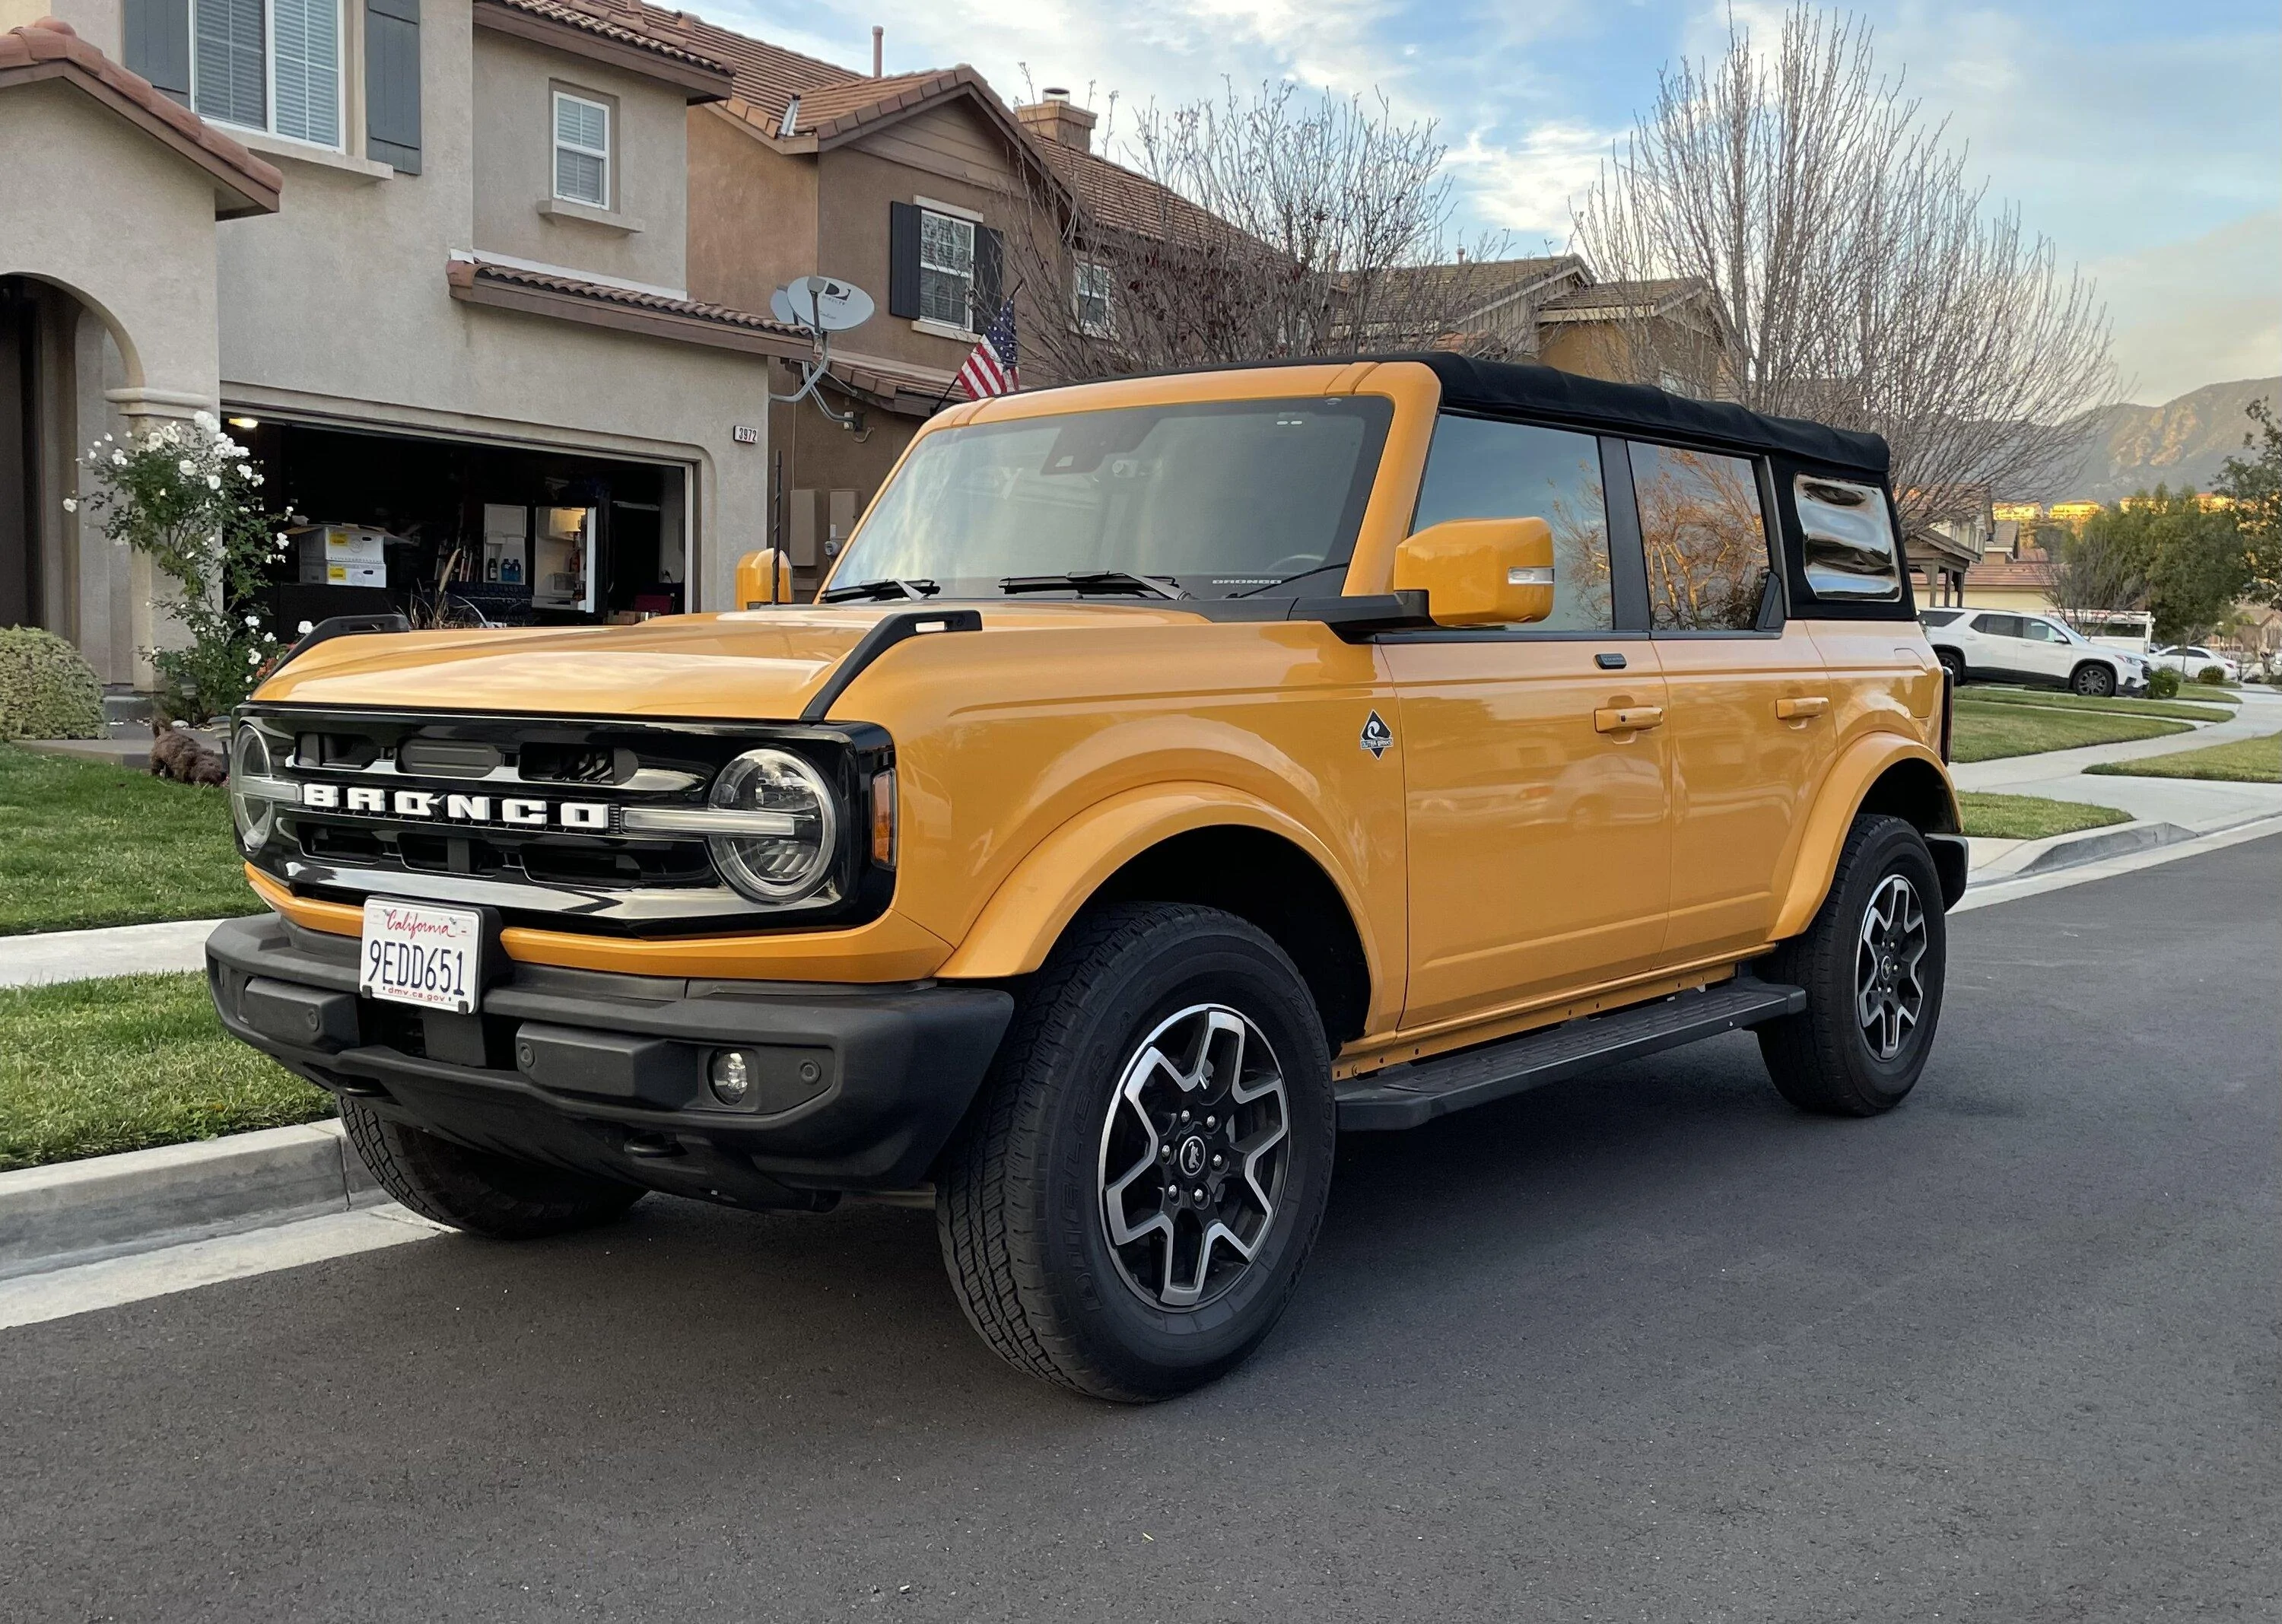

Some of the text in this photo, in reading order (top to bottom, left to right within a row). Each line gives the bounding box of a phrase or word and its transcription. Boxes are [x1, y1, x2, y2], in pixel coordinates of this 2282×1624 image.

[739, 427, 757, 441] 3972
[304, 783, 609, 830] BRONCO
[386, 909, 456, 939] California
[367, 939, 465, 996] 9EDD651
[388, 987, 446, 1002] dmv.ca.gov
